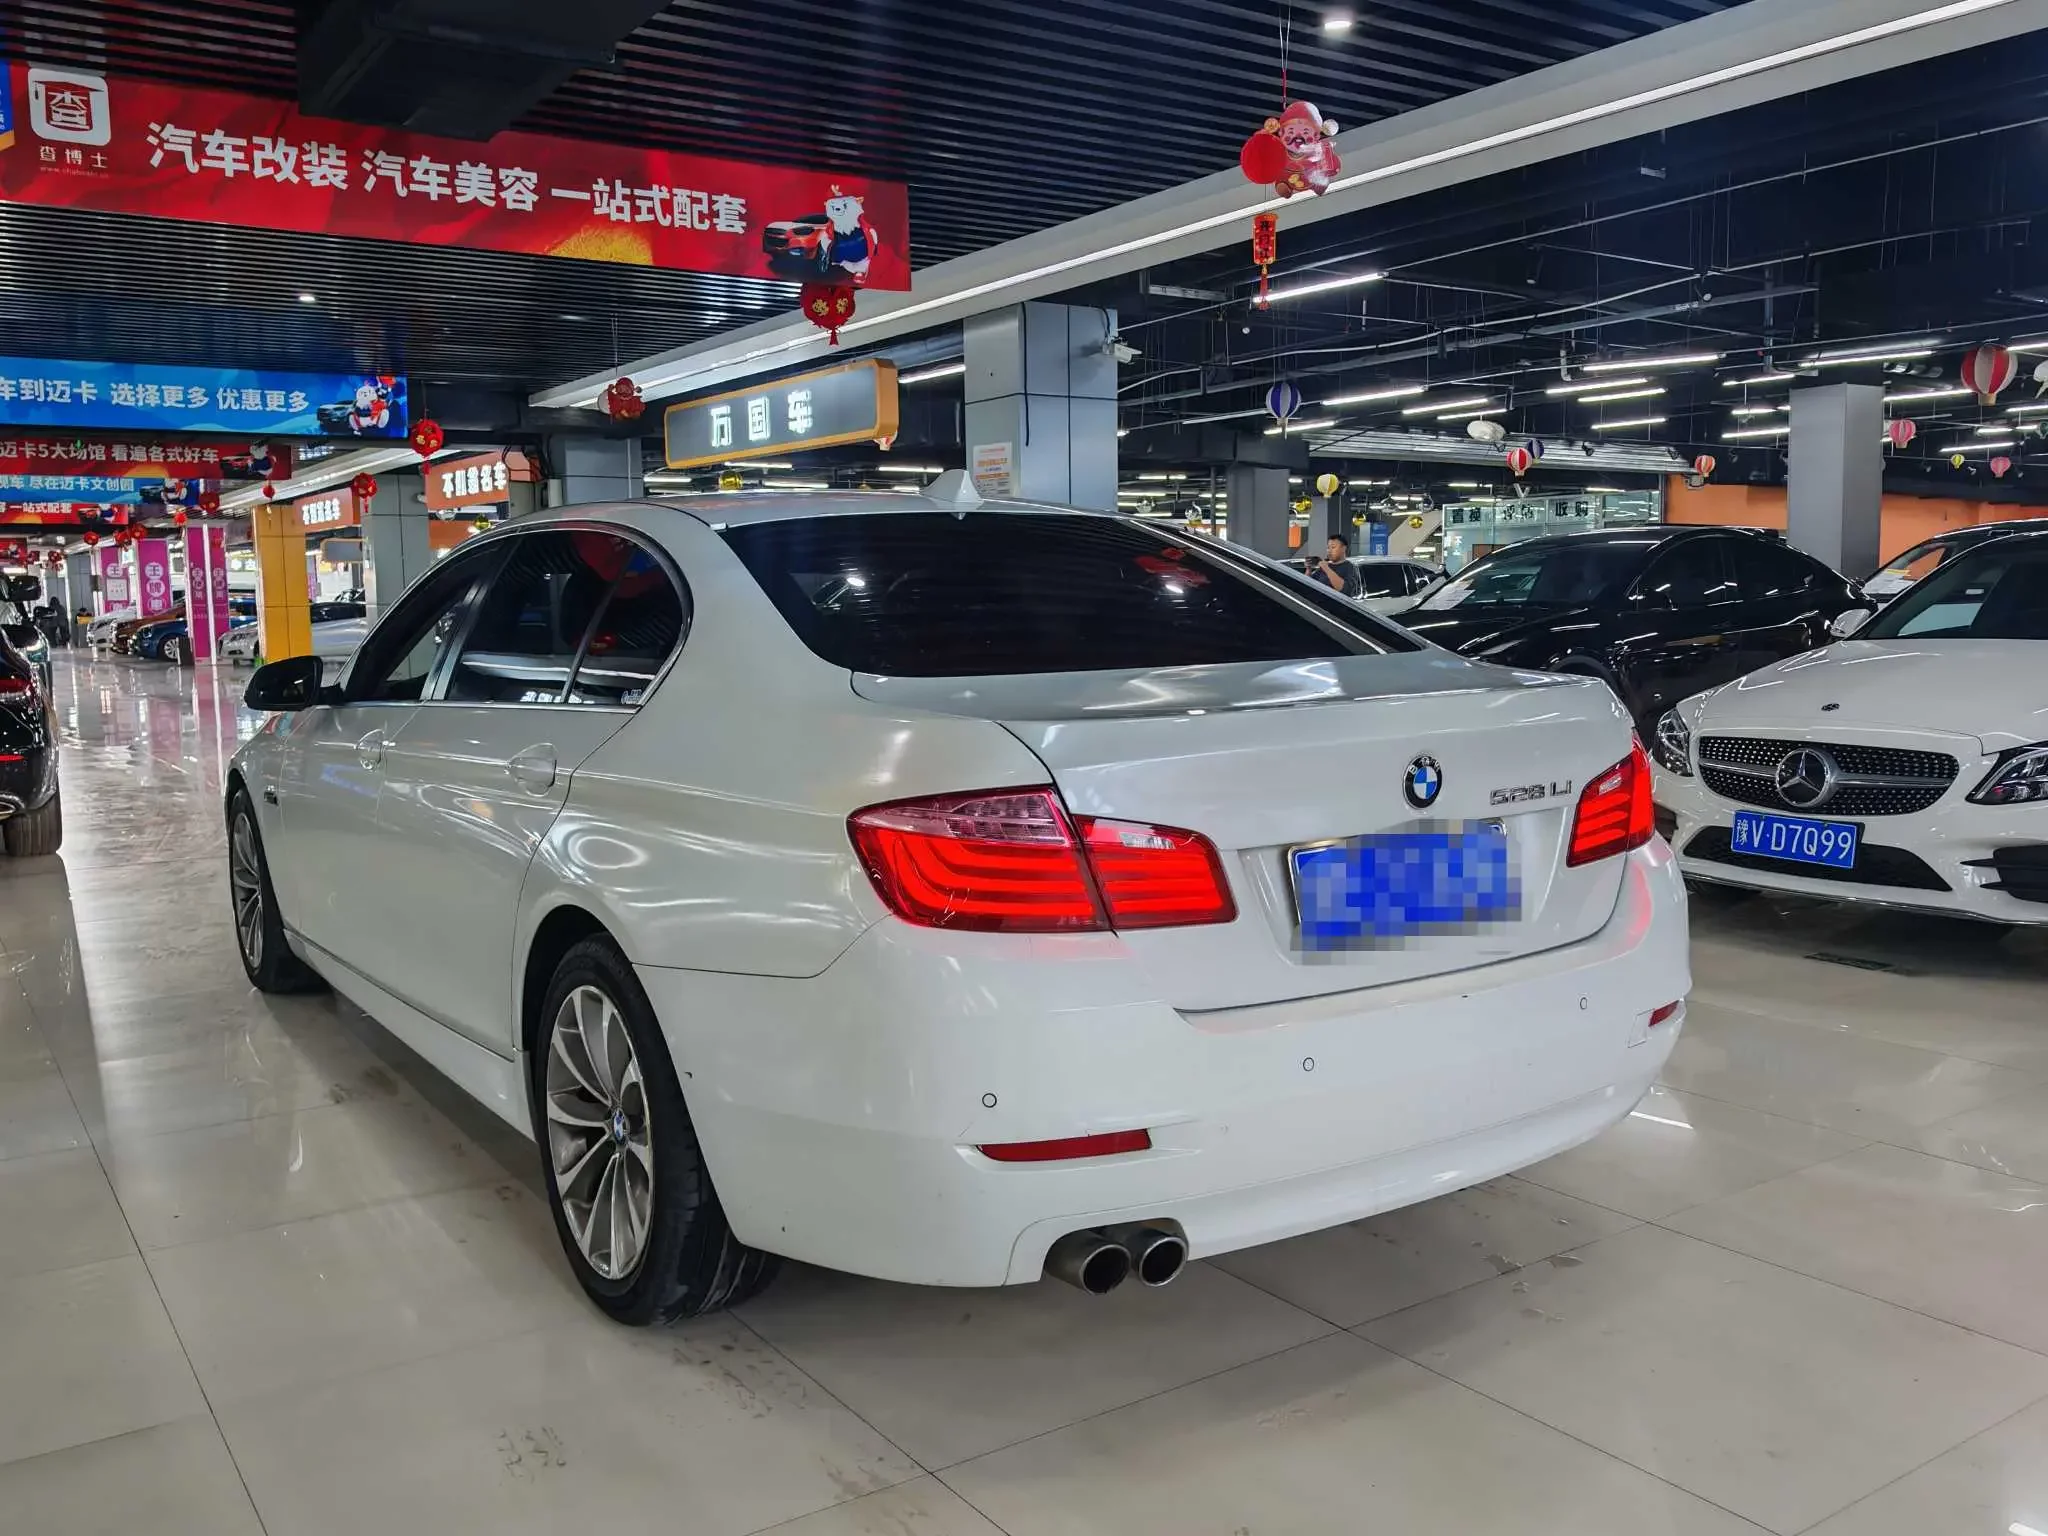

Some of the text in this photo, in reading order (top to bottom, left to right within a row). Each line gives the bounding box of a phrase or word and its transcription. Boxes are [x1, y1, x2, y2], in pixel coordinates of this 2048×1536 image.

[40, 146, 107, 168] 查博士
[146, 121, 747, 234] 汽车改装 汽车美容 一站式配套
[0, 377, 310, 413] 车到迈卡 选择更多 优惠更多
[0, 441, 219, 464] 迈卡5大场馆 看遍各式好车
